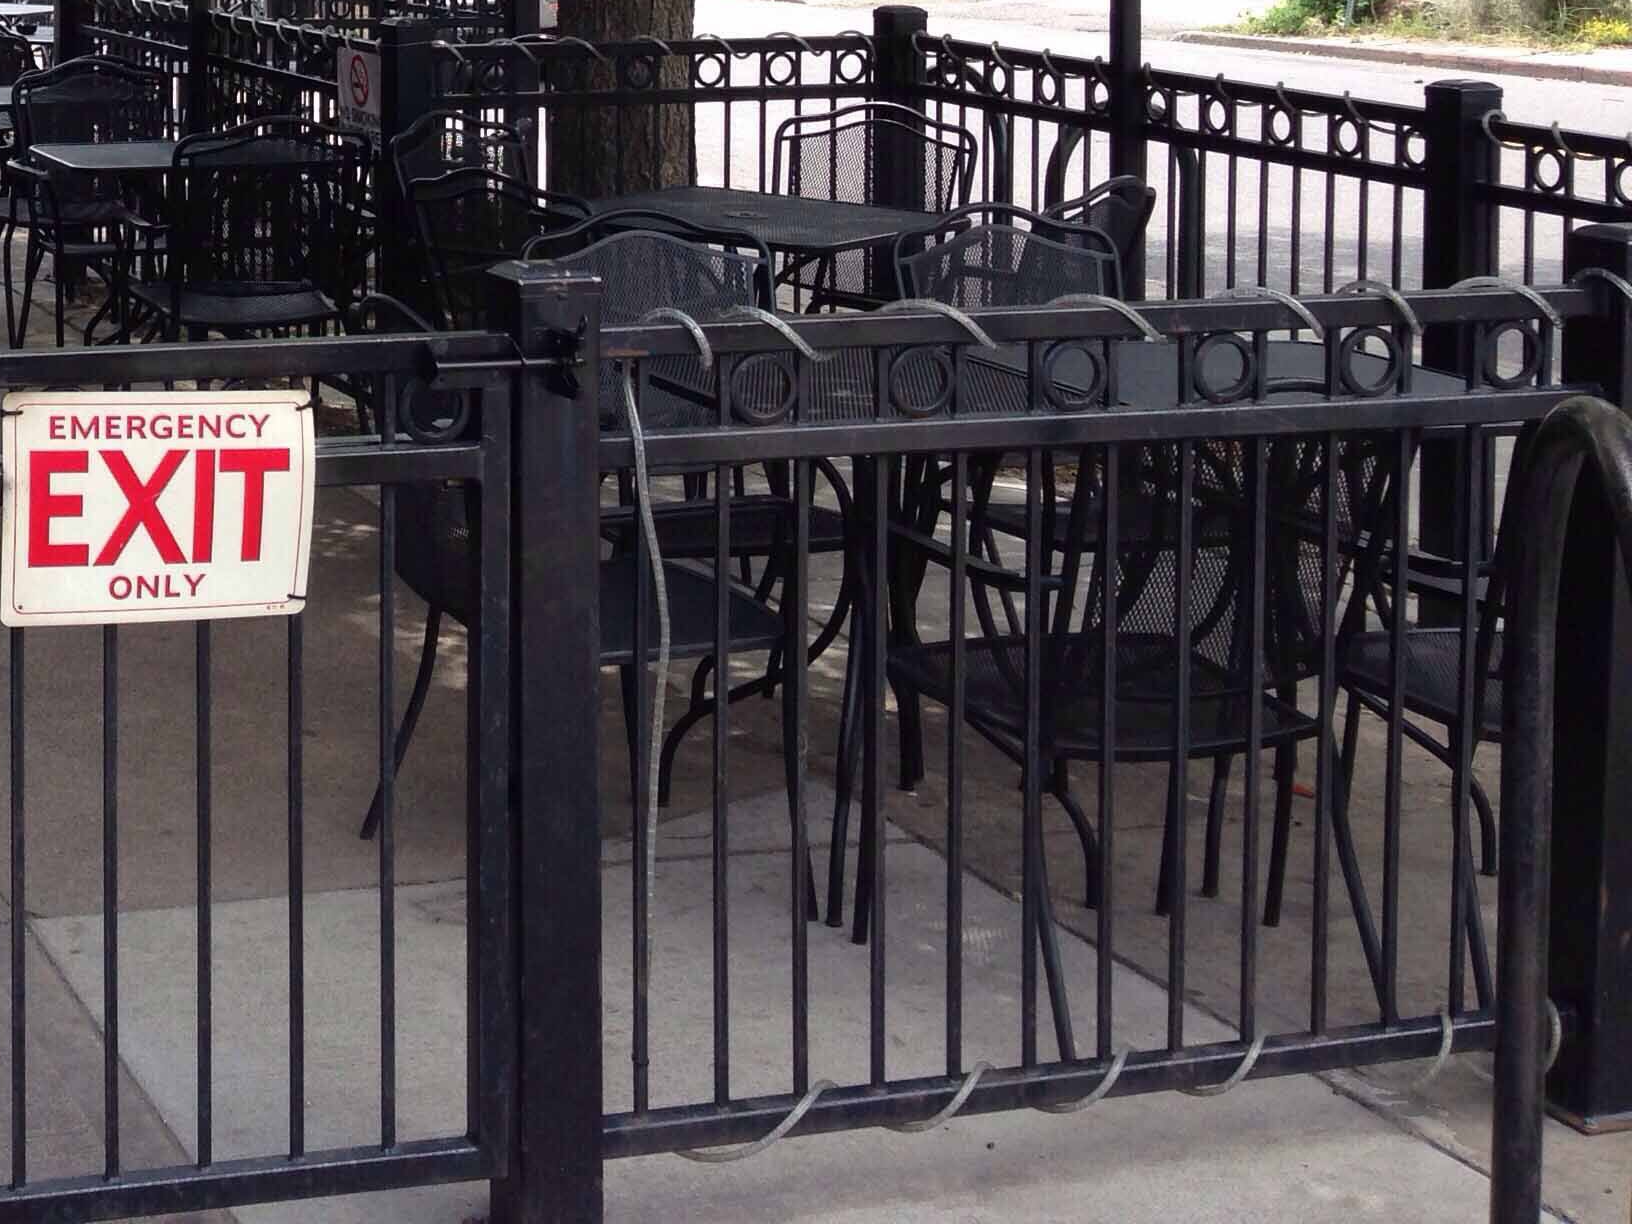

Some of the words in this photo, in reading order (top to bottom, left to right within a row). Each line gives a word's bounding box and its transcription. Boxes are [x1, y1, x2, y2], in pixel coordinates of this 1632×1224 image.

[48, 413, 271, 440] EMERGENCY
[28, 447, 291, 568] EXIT
[108, 573, 206, 600] ONLY
